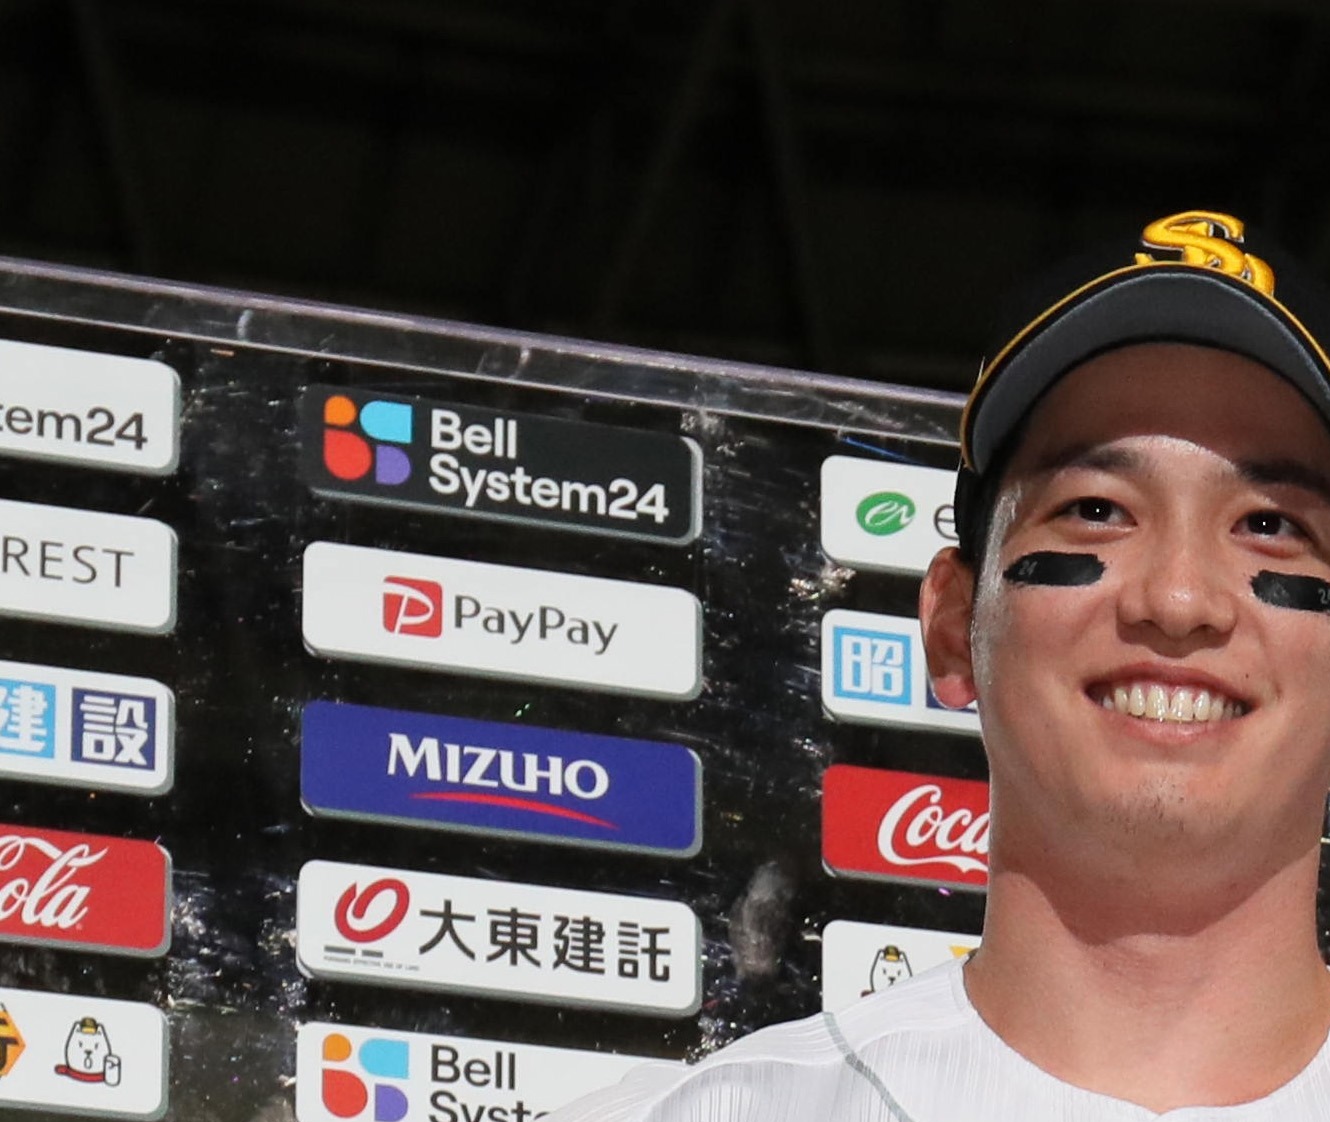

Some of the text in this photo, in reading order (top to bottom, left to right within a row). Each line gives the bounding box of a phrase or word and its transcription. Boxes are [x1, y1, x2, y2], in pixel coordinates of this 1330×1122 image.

[430, 409, 518, 459] Bell
[428, 454, 670, 524] System24
[2, 535, 135, 588] REST
[454, 595, 619, 656] PayPay
[387, 733, 609, 800] MIZUHO
[419, 899, 671, 983] 大東建託
[430, 1044, 516, 1091] Bell
